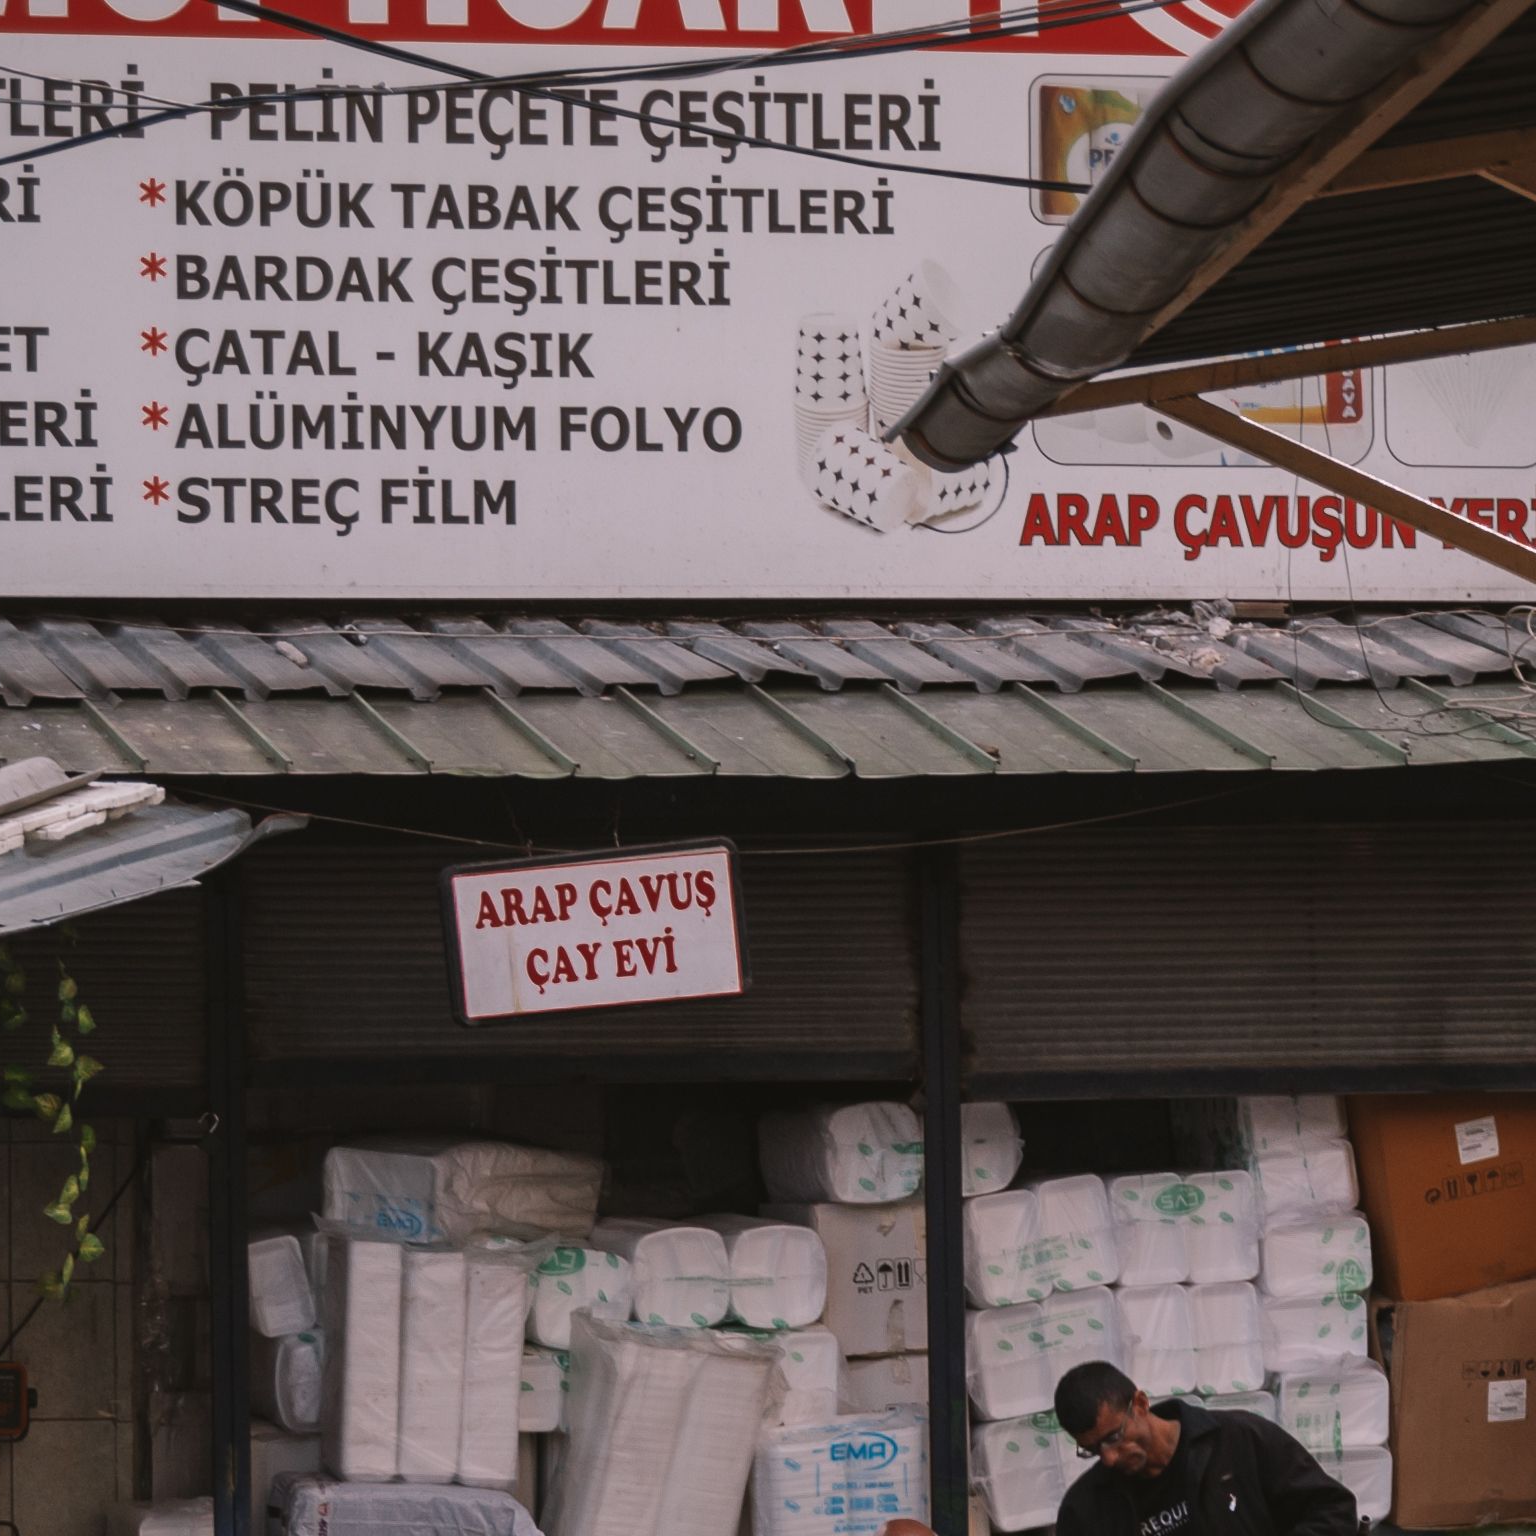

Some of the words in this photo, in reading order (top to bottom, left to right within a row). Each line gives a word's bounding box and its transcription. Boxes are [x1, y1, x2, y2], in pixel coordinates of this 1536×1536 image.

[209, 68, 384, 142] PELİN
[408, 86, 620, 161] PEÇETE
[639, 75, 941, 163] ÇEŞİTLERİ
[174, 168, 375, 228] KÖPÜK
[393, 184, 581, 232] TABAK
[598, 176, 896, 244] ÇEŞİTLERİ
[174, 255, 413, 301] BARDAK
[431, 246, 732, 316] ÇEŞİTLERİ
[174, 328, 357, 386] ÇATAL
[418, 331, 595, 388] KAŞIK
[174, 391, 536, 451] ALÜMİNYUM
[561, 405, 742, 453] FOLYO
[175, 478, 360, 536] STREÇ
[381, 466, 518, 526] FİLM
[1020, 493, 1160, 547] ARAP
[1173, 495, 1417, 562] ÇAVUŞUN
[475, 883, 577, 929] ARAP
[589, 870, 716, 926] ÇAVUŞ
[526, 942, 602, 995] ÇAY
[613, 926, 678, 978] EVİ
[830, 1441, 887, 1461] EMA
